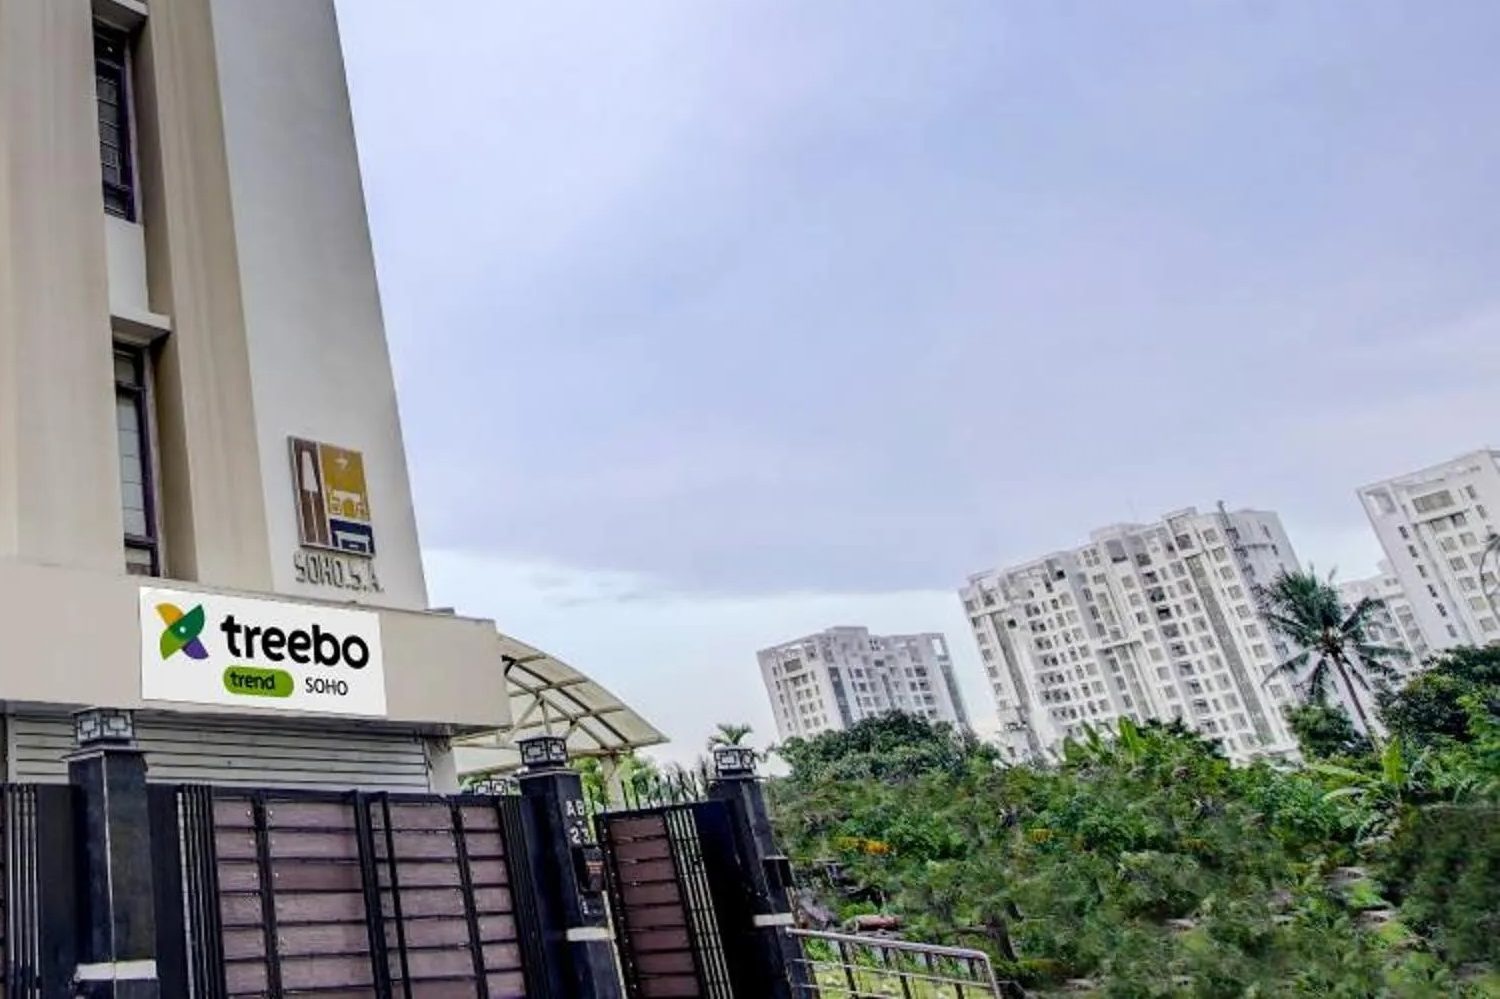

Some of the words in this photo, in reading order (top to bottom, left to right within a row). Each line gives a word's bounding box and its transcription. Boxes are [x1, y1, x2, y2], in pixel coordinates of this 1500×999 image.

[220, 614, 369, 669] treebo
[230, 672, 275, 690] trend
[305, 677, 348, 696] SOHO
